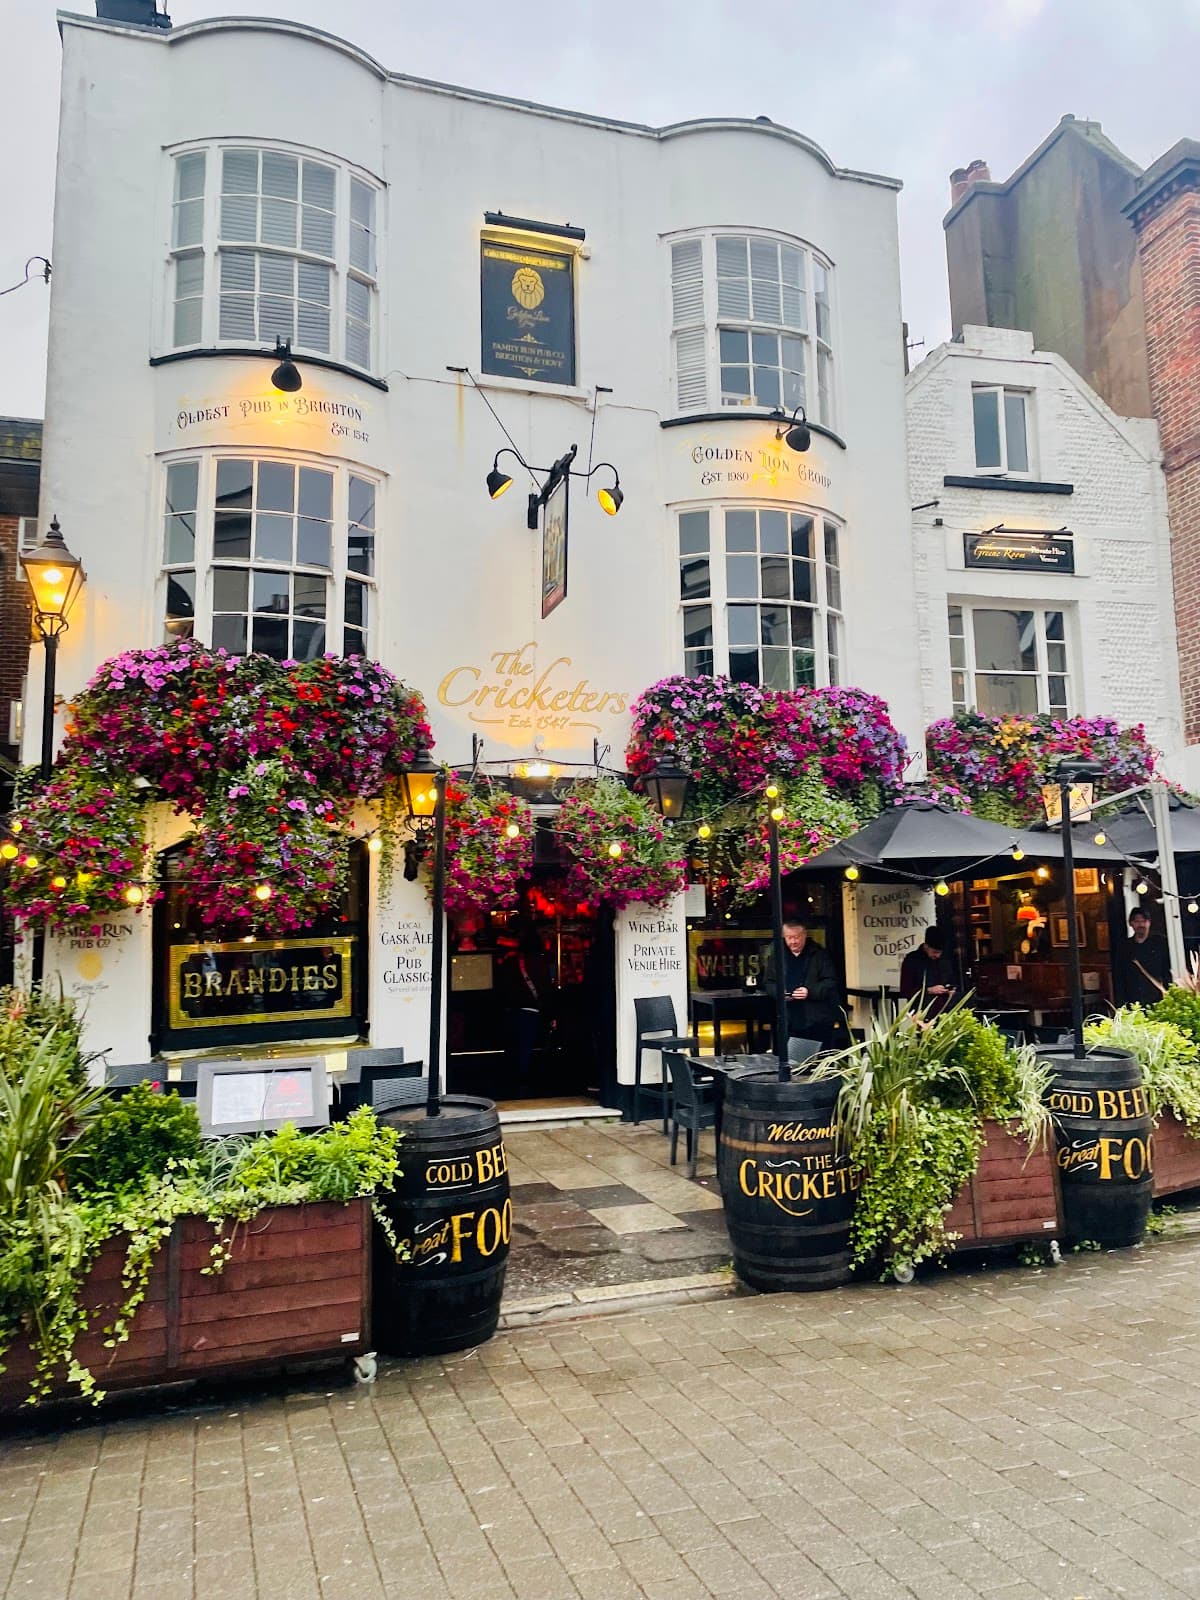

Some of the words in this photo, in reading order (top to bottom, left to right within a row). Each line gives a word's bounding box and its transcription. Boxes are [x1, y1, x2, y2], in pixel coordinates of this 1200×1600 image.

[177, 405, 230, 430] OLDEST
[239, 399, 272, 418] PUB
[279, 400, 289, 411] IN
[294, 397, 363, 422] BRIGHTON
[353, 429, 370, 443] 1547
[691, 446, 753, 464] GOLDEN
[758, 450, 790, 473] LION
[798, 463, 832, 488] GROUP
[491, 641, 538, 676] The
[437, 657, 629, 715] Cricketers
[536, 714, 570, 730] 1547
[871, 888, 910, 907] FAMOUS
[628, 920, 656, 933] WINE
[657, 920, 679, 933] BAR
[863, 914, 909, 928] CENTURY
[911, 915, 929, 927] INN
[103, 923, 133, 938] RUN
[381, 932, 410, 945] CASK
[873, 934, 888, 943] THE
[70, 939, 93, 949] PUB
[633, 943, 677, 957] PRIVATE
[873, 934, 915, 956] OLDEST
[397, 956, 422, 969] PUB
[628, 958, 657, 971] VENUE
[659, 957, 682, 970] HIRE
[700, 954, 769, 977] WHIS
[183, 964, 338, 999] BRANDIES
[1050, 1093, 1093, 1113] COLD
[803, 1155, 832, 1170] THE
[1057, 1142, 1102, 1170] Great
[425, 1163, 473, 1184] COLD
